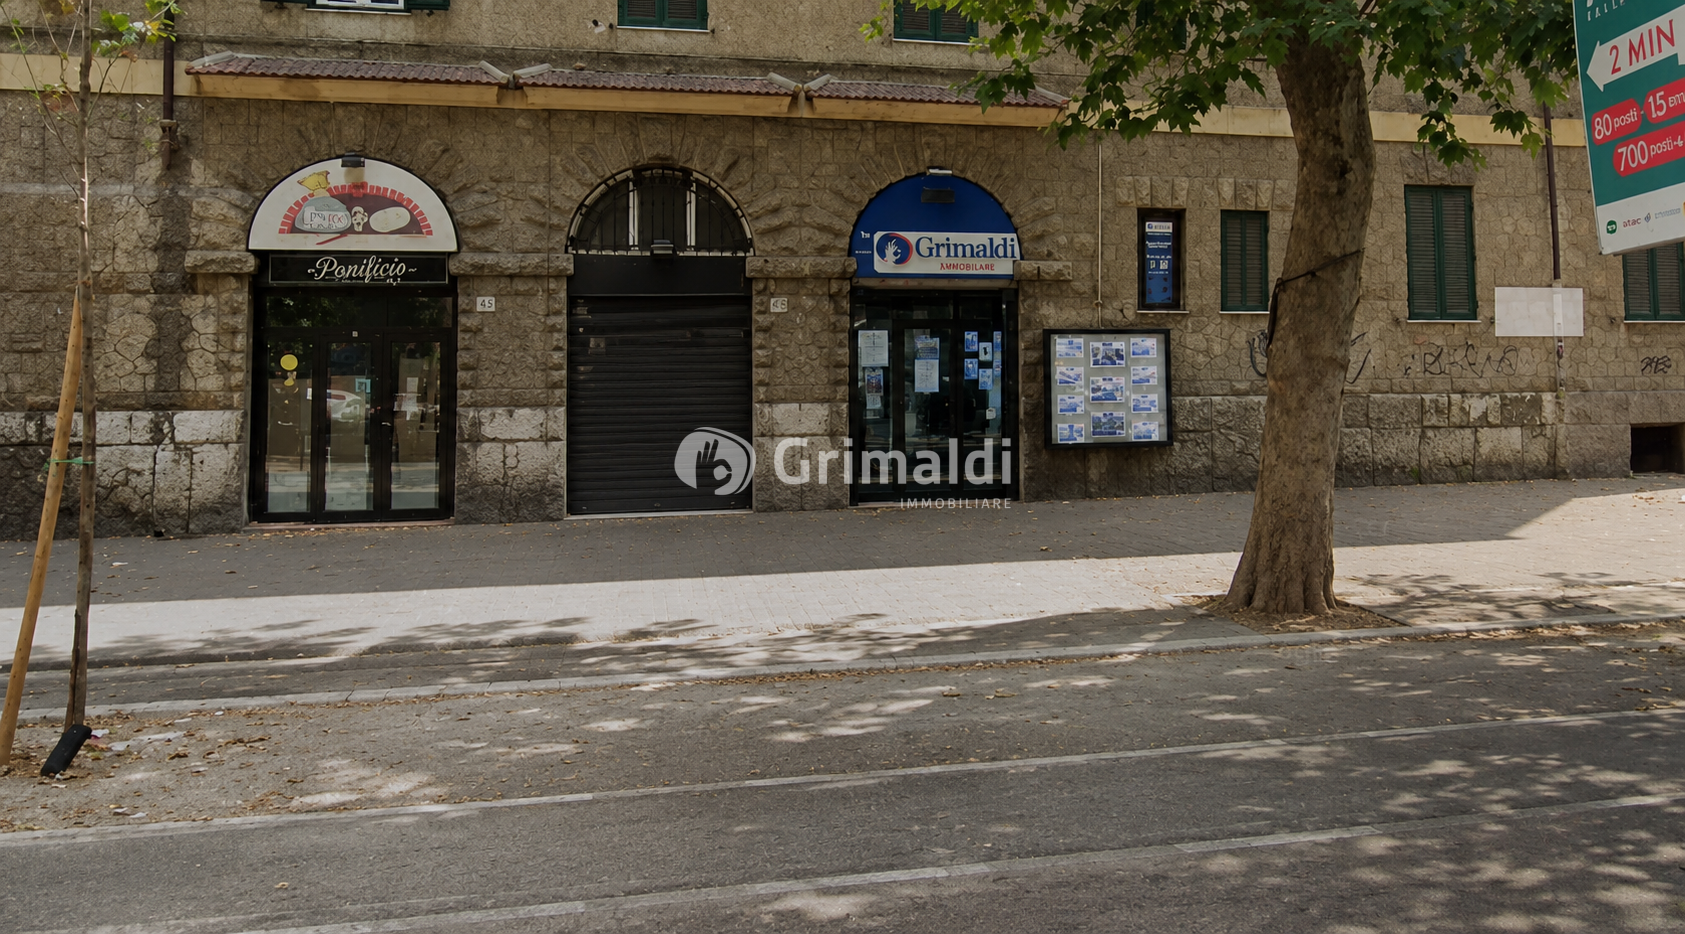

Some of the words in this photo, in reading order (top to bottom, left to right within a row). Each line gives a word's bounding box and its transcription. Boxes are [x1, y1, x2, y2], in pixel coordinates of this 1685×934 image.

[1609, 44, 1621, 75] 2
[1628, 19, 1675, 66] MIN
[1594, 113, 1612, 140] 80
[1613, 107, 1638, 131] posti
[1648, 91, 1667, 118] 15
[1617, 140, 1649, 172] 700
[915, 236, 1017, 259] Grimaldi
